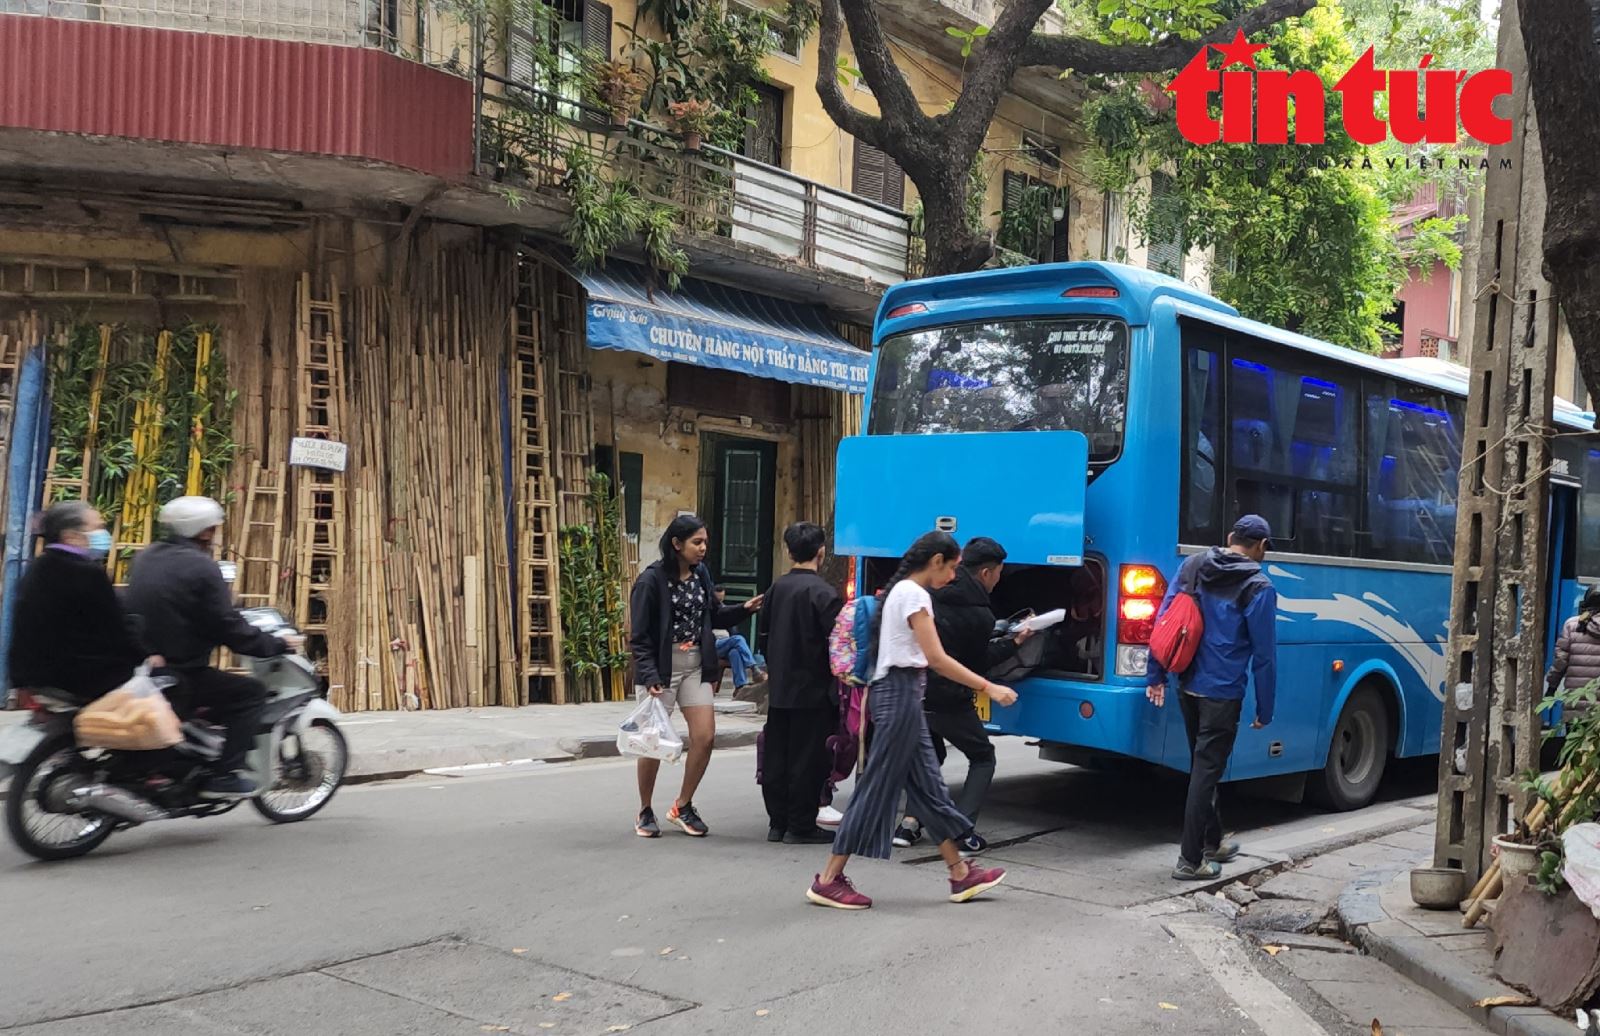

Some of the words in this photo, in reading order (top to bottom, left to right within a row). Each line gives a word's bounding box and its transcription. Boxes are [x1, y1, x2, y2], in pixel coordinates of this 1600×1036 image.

[650, 326, 702, 353] CHUYÊN
[705, 335, 740, 359] HÀNG
[742, 341, 765, 367] NỘI
[766, 345, 796, 369] THẤT
[798, 348, 828, 376] BẰNG
[829, 362, 849, 380] TRE
